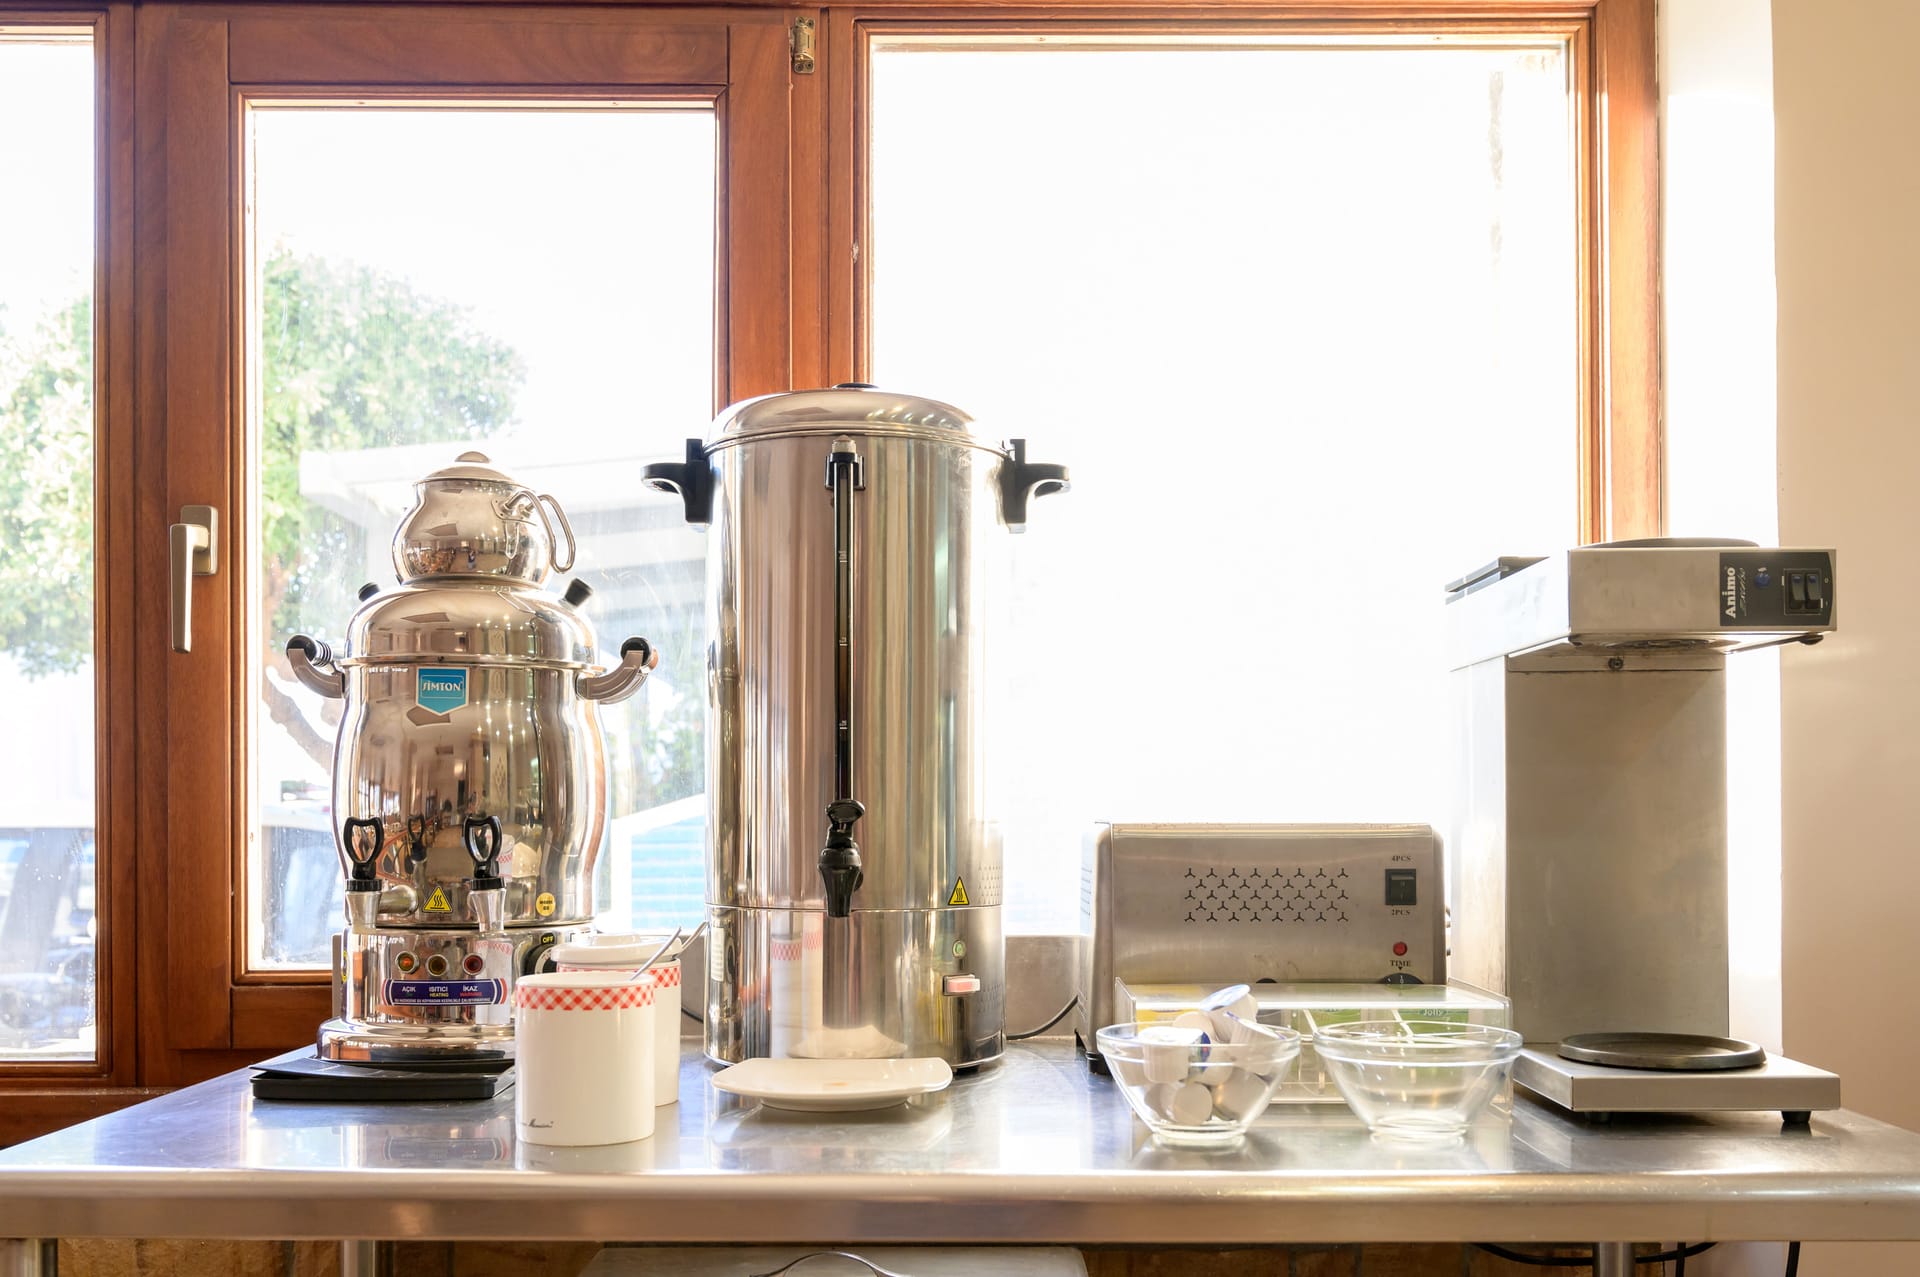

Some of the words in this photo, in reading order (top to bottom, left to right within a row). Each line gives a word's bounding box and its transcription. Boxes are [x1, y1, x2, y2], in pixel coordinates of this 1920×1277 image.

[1722, 567, 1736, 619] Animo
[1391, 908, 1411, 916] 2PCS
[542, 935, 554, 943] OFF
[1389, 959, 1412, 967] TIME
